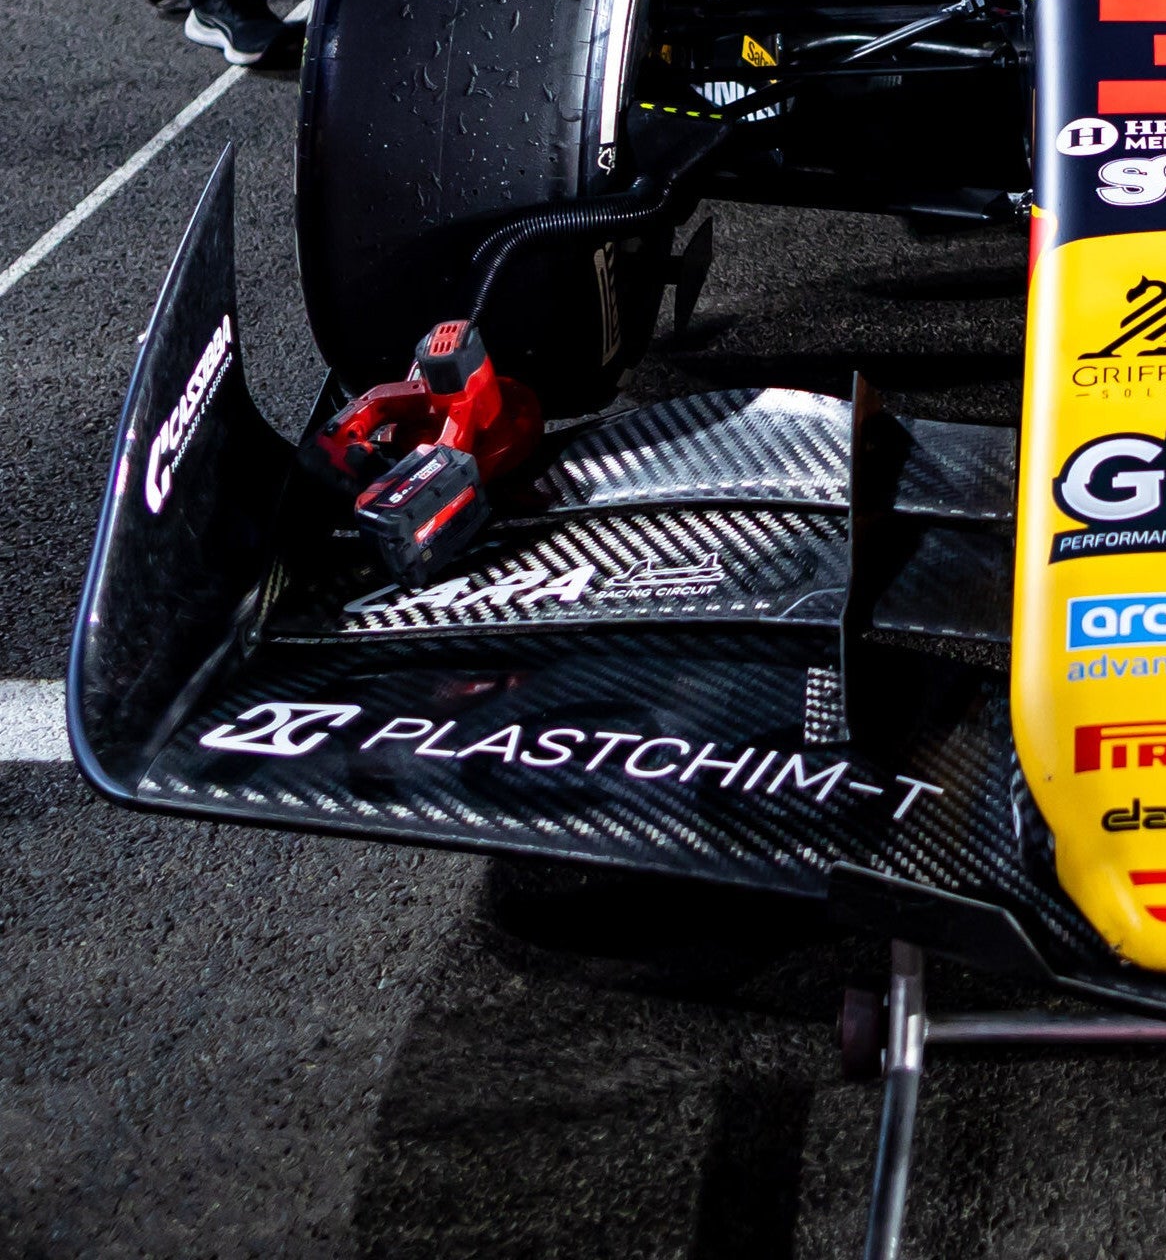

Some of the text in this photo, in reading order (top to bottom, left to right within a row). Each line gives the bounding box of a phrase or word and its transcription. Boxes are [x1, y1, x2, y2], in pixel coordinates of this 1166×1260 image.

[1068, 127, 1106, 147] H
[655, 584, 718, 597] CIRCUIT
[361, 716, 944, 822] PLASTCHIM-T
